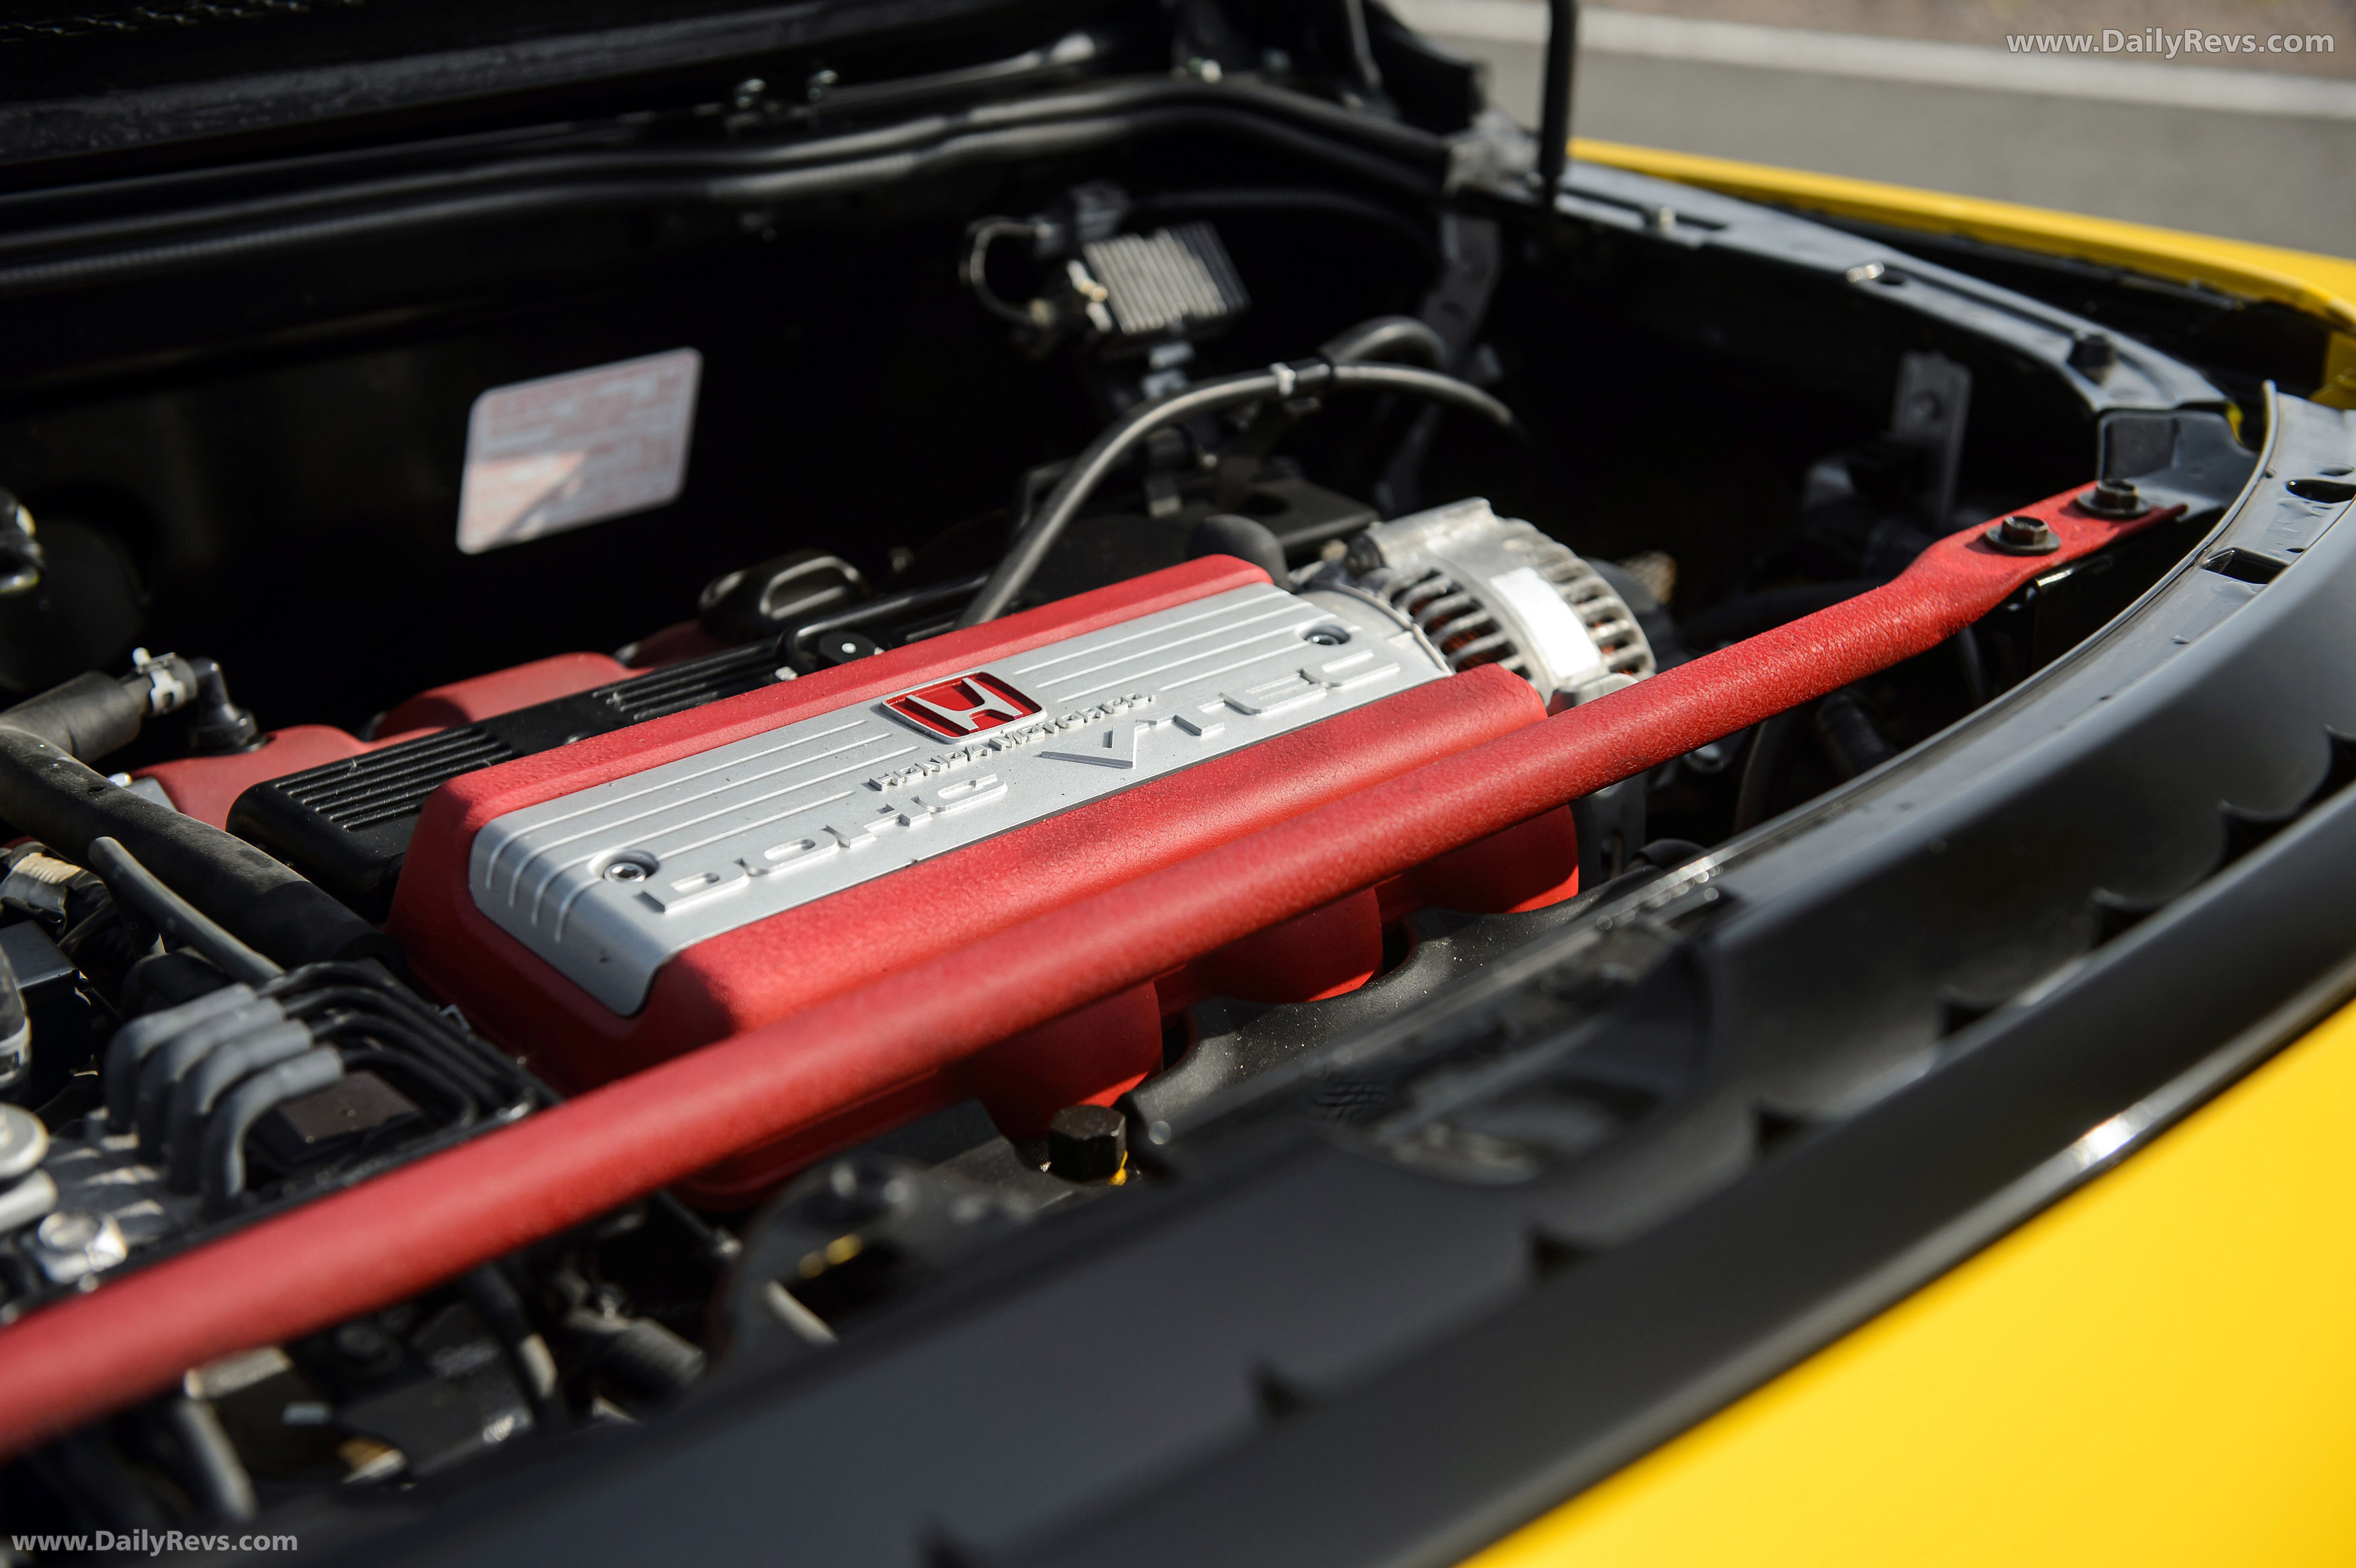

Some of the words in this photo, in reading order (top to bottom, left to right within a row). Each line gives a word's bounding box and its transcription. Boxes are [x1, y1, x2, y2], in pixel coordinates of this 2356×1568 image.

[635, 765, 1009, 914] DOHC
[1039, 643, 1401, 769] VTEC
[869, 743, 992, 791] HONDA
[988, 705, 1105, 752] MOTOR
